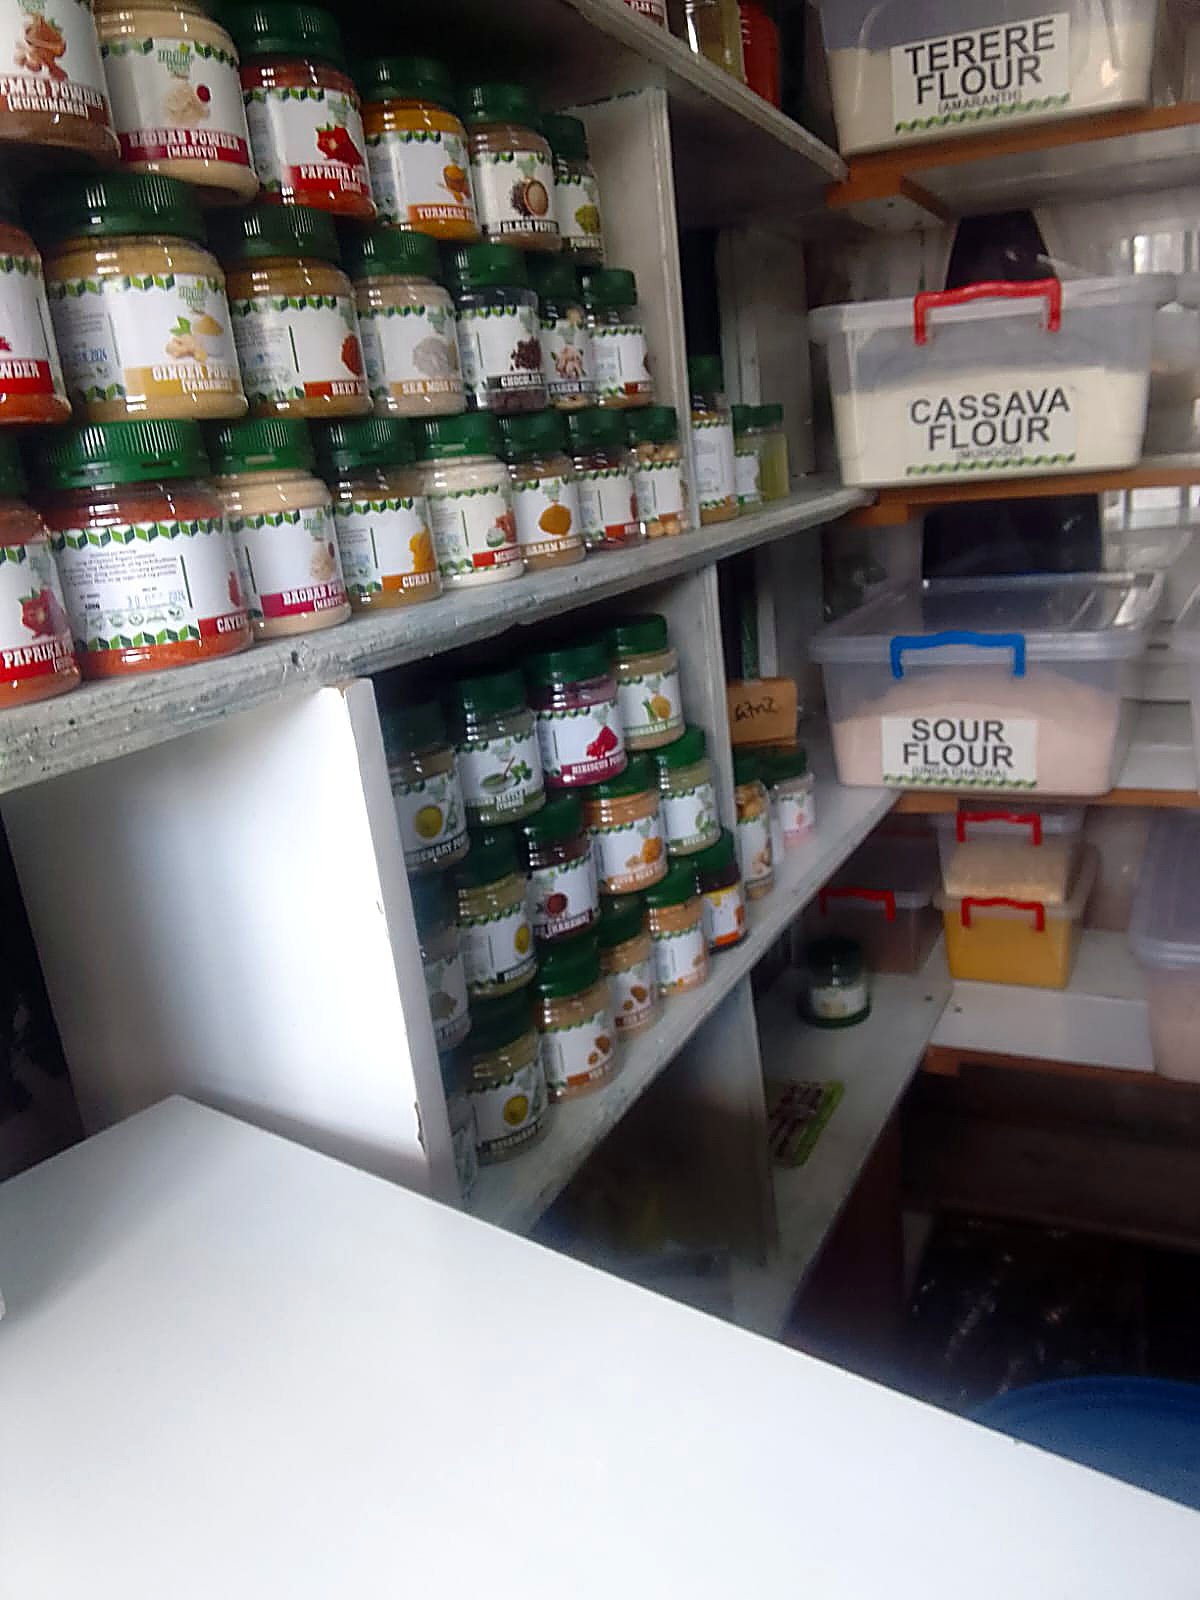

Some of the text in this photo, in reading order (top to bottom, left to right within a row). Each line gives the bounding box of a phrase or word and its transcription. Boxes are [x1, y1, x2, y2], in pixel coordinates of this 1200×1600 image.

[905, 19, 1054, 75] TERERE
[917, 55, 1042, 105] FLOUR
[911, 386, 1070, 424] CASSAVA
[929, 416, 1050, 451] FLOUR
[911, 718, 1005, 743] SOUR
[902, 743, 1014, 768] FLOUR
